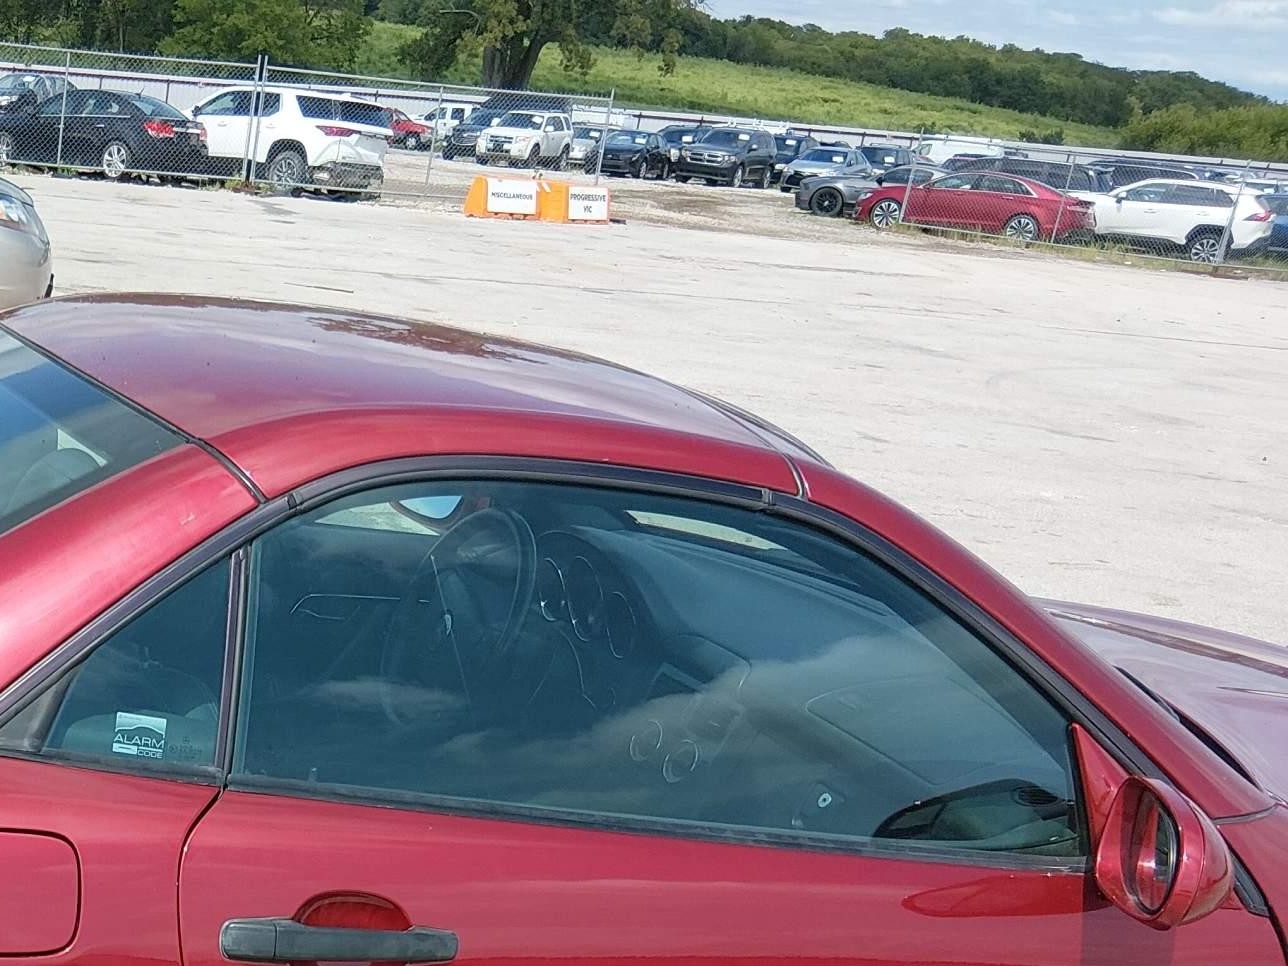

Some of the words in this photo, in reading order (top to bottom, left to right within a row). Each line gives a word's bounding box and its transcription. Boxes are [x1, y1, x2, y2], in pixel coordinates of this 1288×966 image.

[490, 191, 534, 200] MISCELLANEOUS
[569, 193, 607, 202] PROGRESSIVE
[583, 205, 593, 213] VIC
[113, 733, 165, 748] ALARM
[137, 749, 163, 759] CODE
